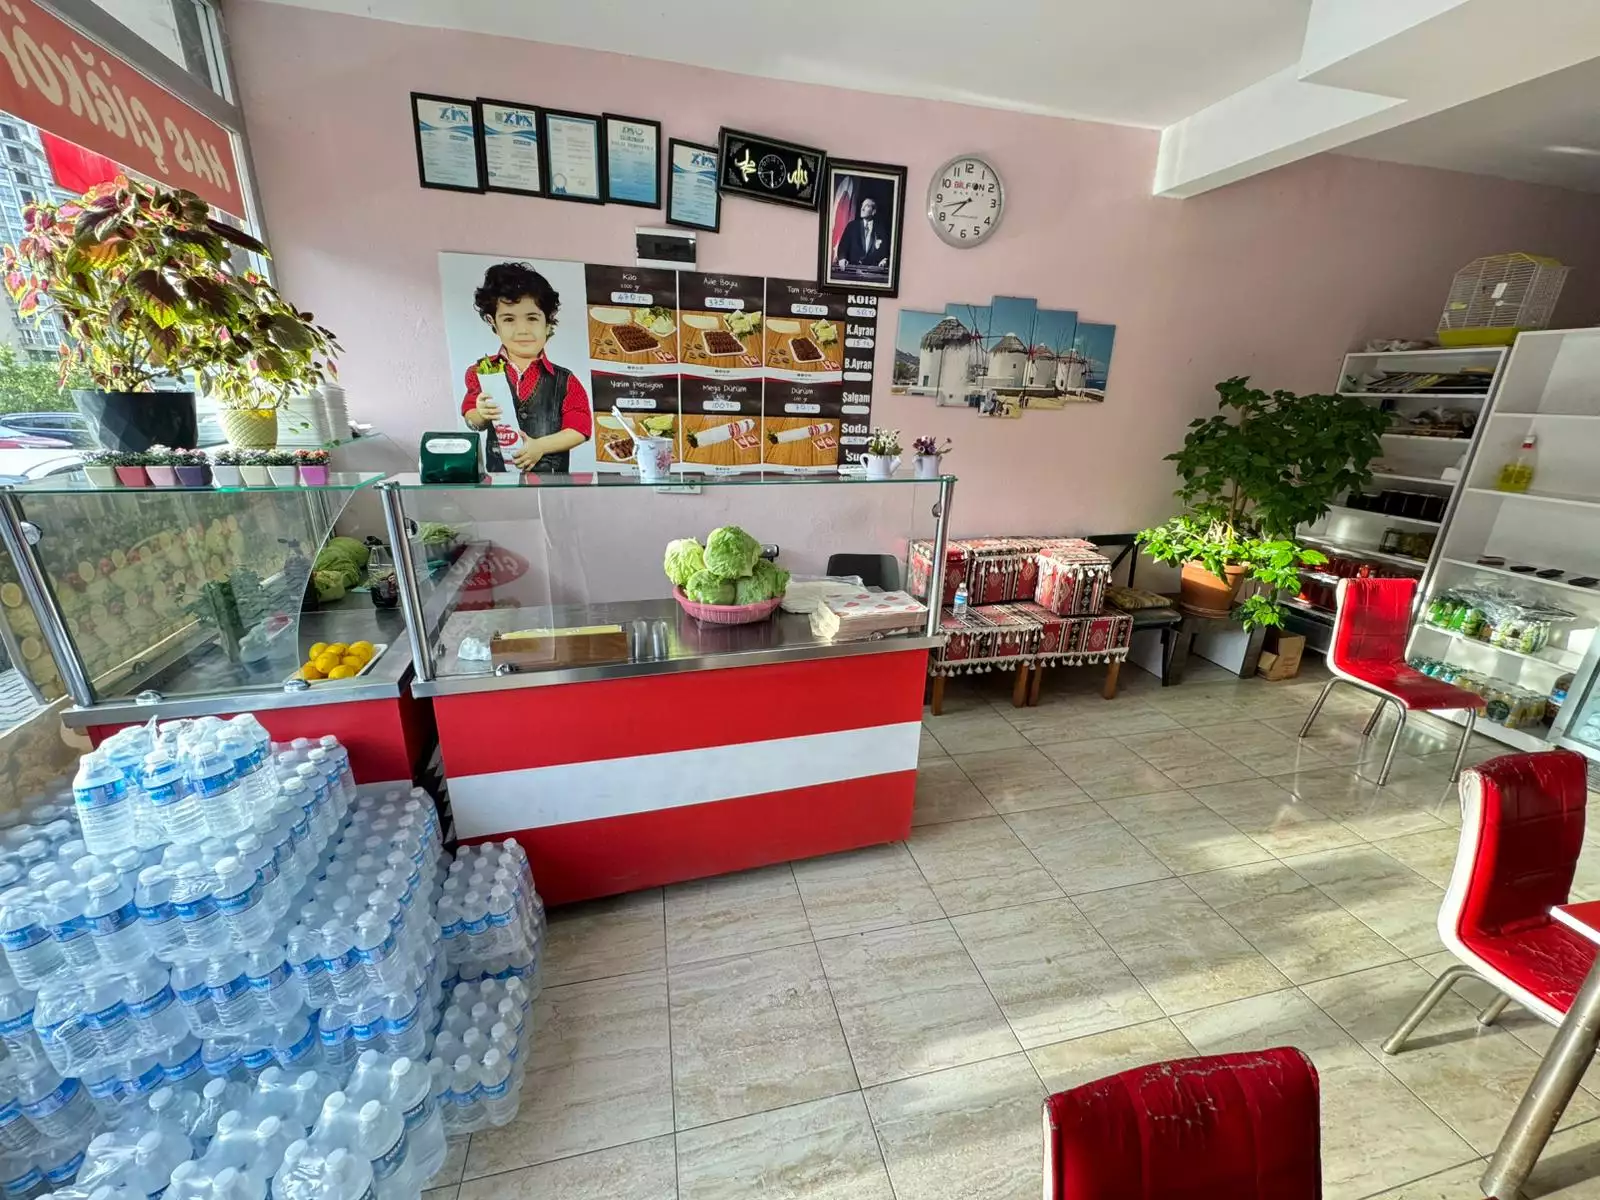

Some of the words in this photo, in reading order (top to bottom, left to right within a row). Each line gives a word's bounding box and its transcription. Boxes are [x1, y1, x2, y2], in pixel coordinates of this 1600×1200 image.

[953, 167, 960, 177] 11
[965, 162, 975, 174] 12
[981, 169, 985, 180] 1
[942, 178, 951, 189] 10
[987, 183, 995, 193] 2
[936, 193, 943, 203] 9
[990, 198, 996, 208] 3
[939, 211, 946, 221] 8
[984, 216, 990, 226] 4
[948, 223, 955, 233] 7
[973, 225, 980, 235] 5
[960, 229, 967, 239] 6
[622, 273, 637, 281] Kilo
[787, 285, 799, 293] Tam
[846, 324, 874, 337] K.Ayran
[844, 357, 872, 370] B.Ayran
[702, 384, 720, 395] Mega
[841, 423, 868, 434] Soda
